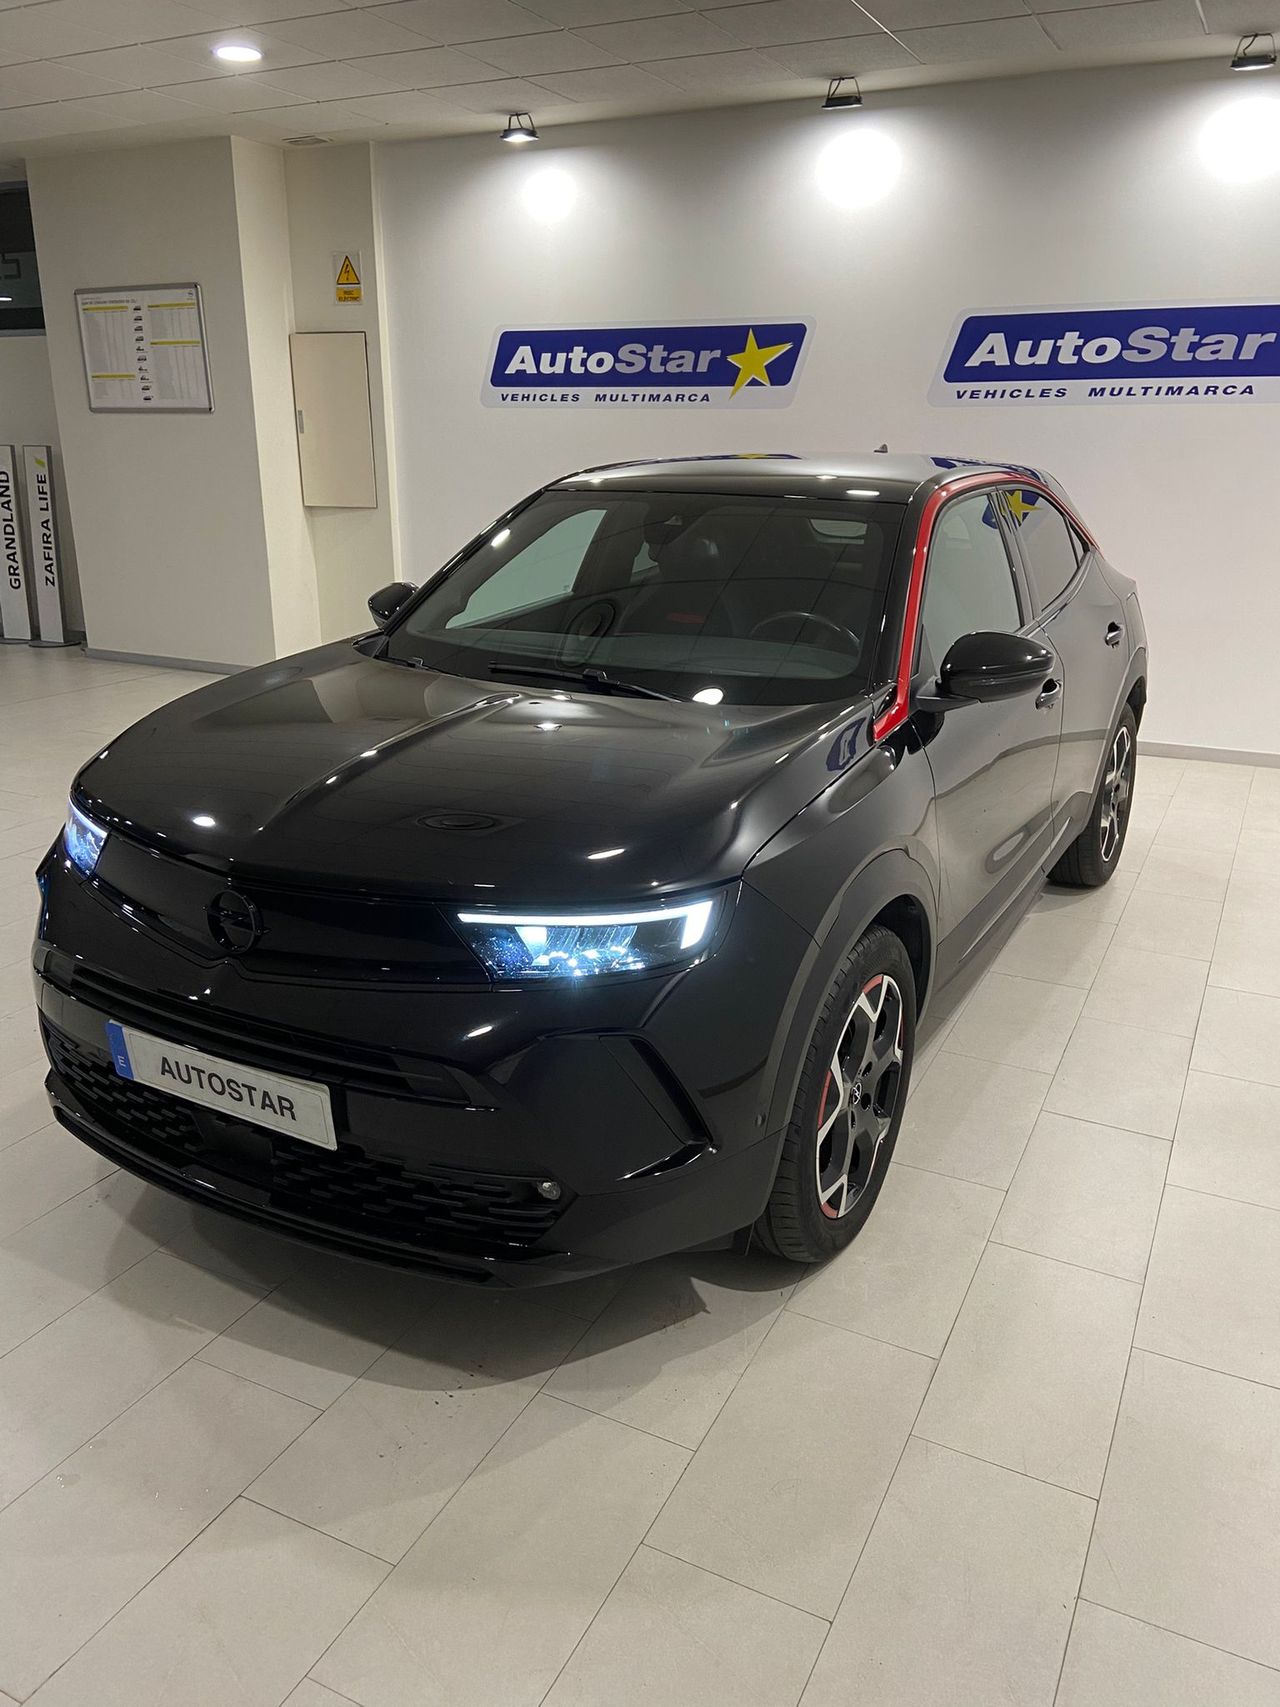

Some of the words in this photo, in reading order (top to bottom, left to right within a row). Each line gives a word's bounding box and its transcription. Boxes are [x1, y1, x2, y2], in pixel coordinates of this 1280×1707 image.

[504, 343, 722, 375] AutoStar
[964, 326, 1278, 368] AutoStar
[500, 393, 581, 402] VEHICLES
[594, 393, 711, 403] MULTIMARCA
[955, 387, 1069, 400] VEHICLES
[1087, 384, 1256, 398] MULTIMARCA
[36, 473, 49, 512] LIFE
[0, 470, 21, 590] GRANDLAND
[41, 519, 55, 587] ZAFIRA
[117, 1055, 127, 1068] E
[160, 1056, 297, 1121] AUTOSTAR
